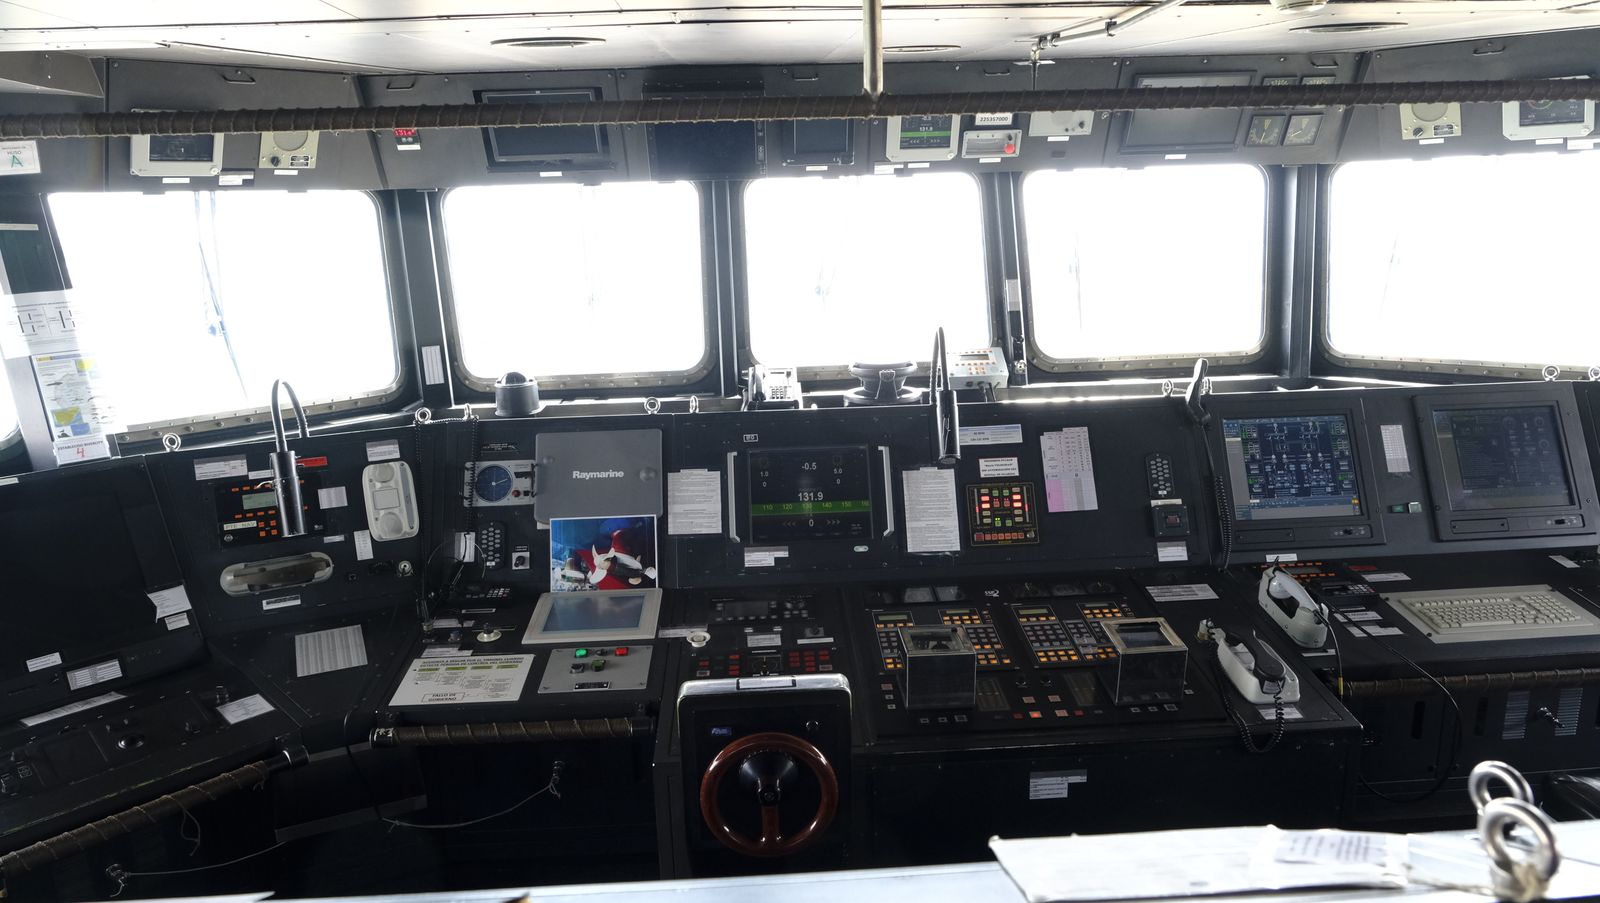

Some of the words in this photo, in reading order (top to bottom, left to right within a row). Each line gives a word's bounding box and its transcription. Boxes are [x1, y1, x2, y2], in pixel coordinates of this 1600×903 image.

[11, 154, 24, 168] A
[76, 448, 85, 458] 4
[801, 462, 817, 470] -0.5
[572, 469, 624, 481] Raymarine
[798, 492, 824, 501] 131.9
